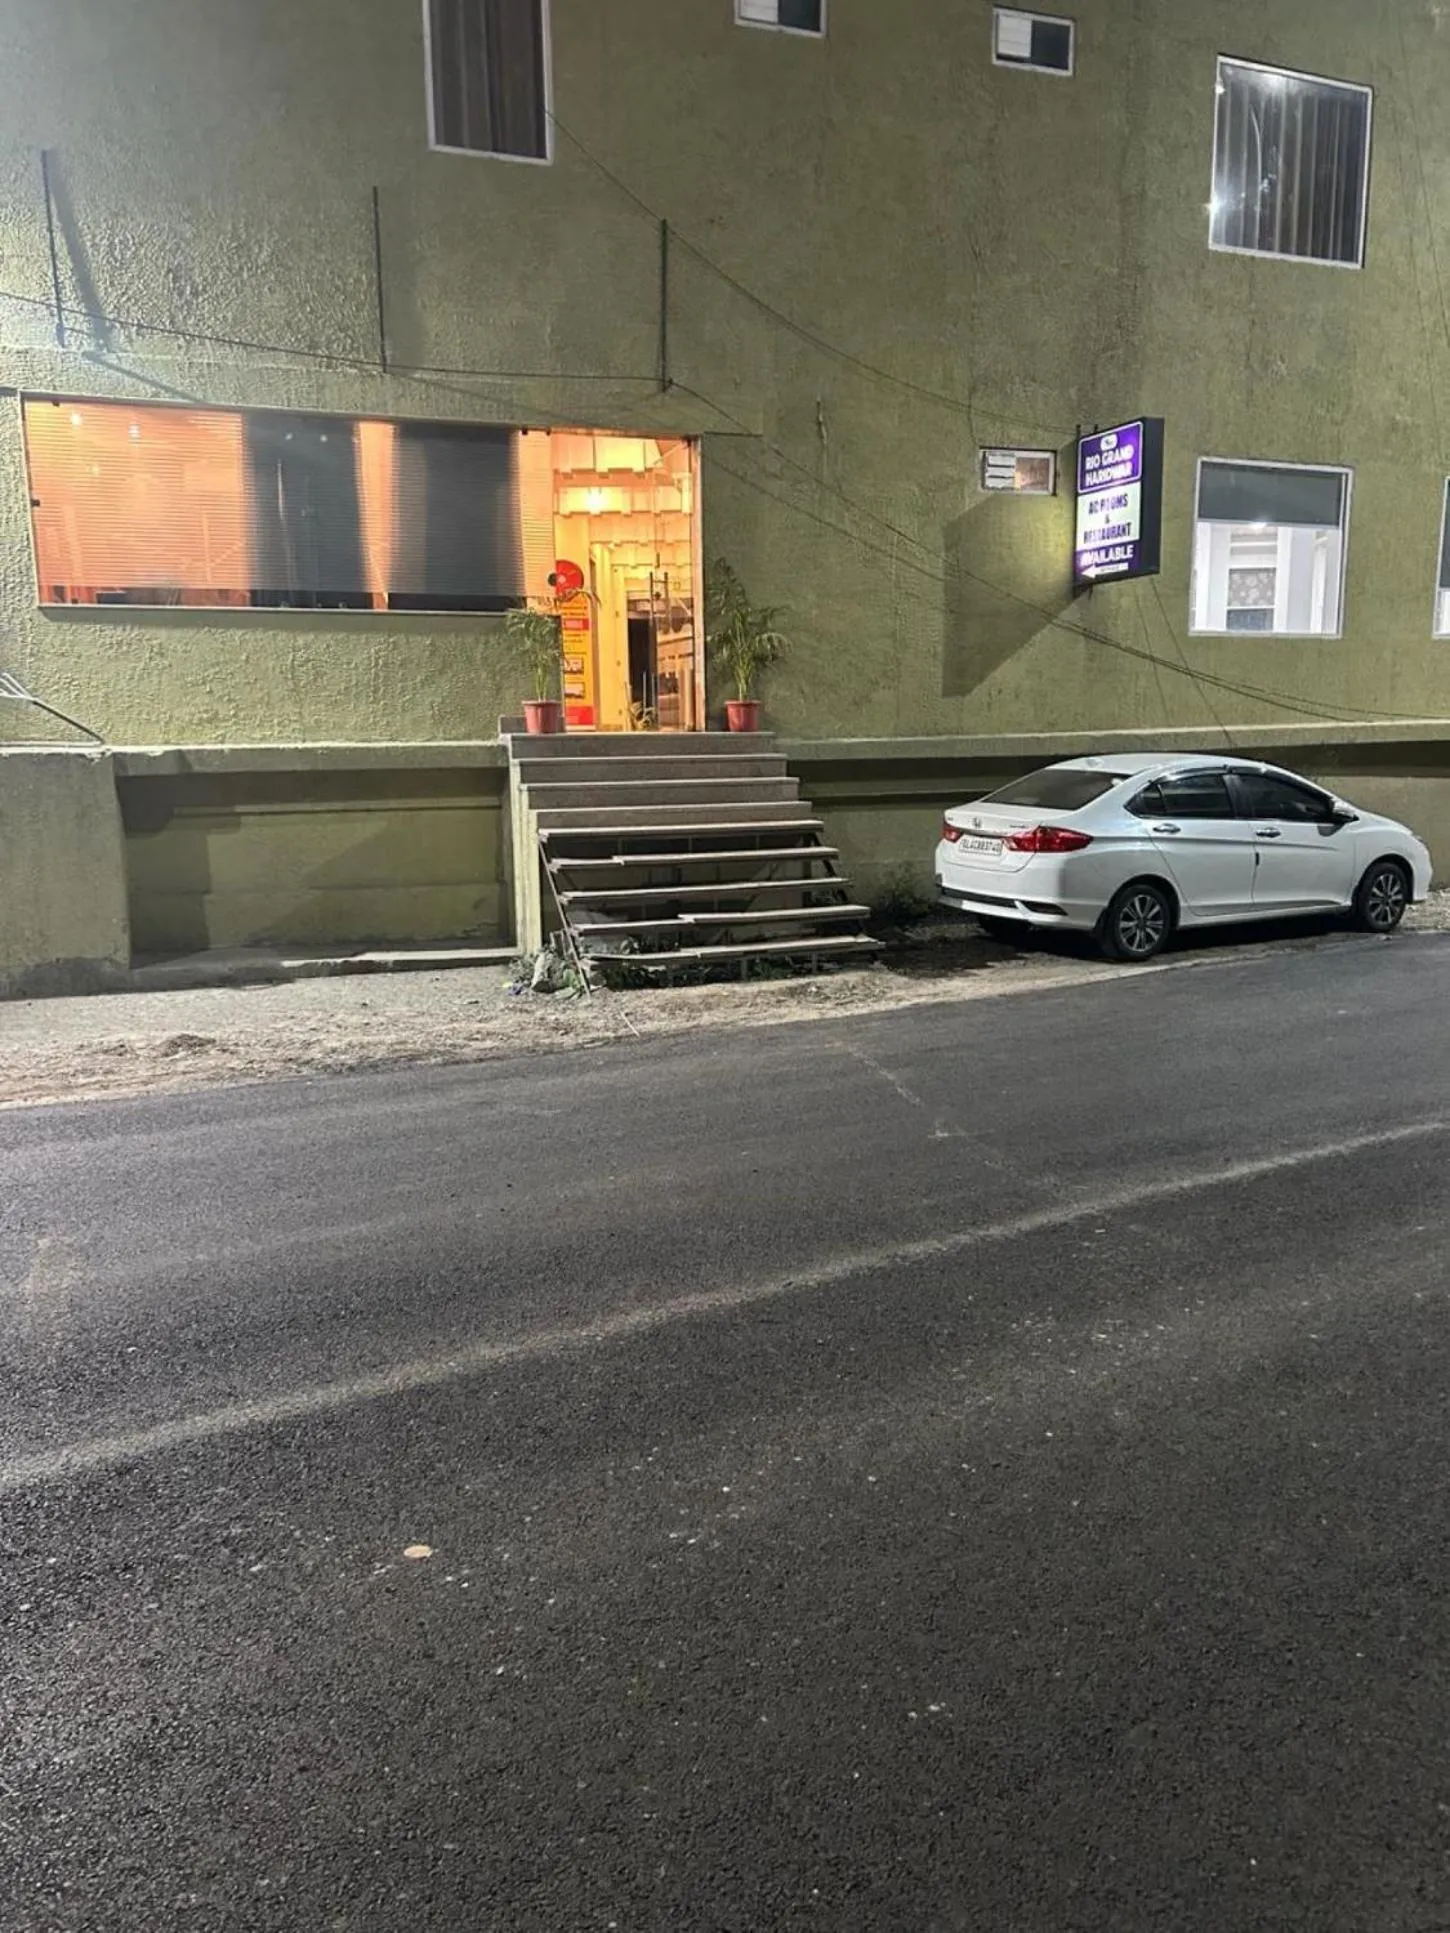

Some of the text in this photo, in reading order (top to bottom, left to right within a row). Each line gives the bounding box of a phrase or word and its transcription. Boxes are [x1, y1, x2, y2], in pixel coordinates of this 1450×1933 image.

[1085, 444, 1134, 470] RIO GRAND
[1085, 462, 1132, 487] HARIDWAR
[1083, 522, 1132, 543] RESTAURANT
[1080, 545, 1134, 569] AVAILABLE
